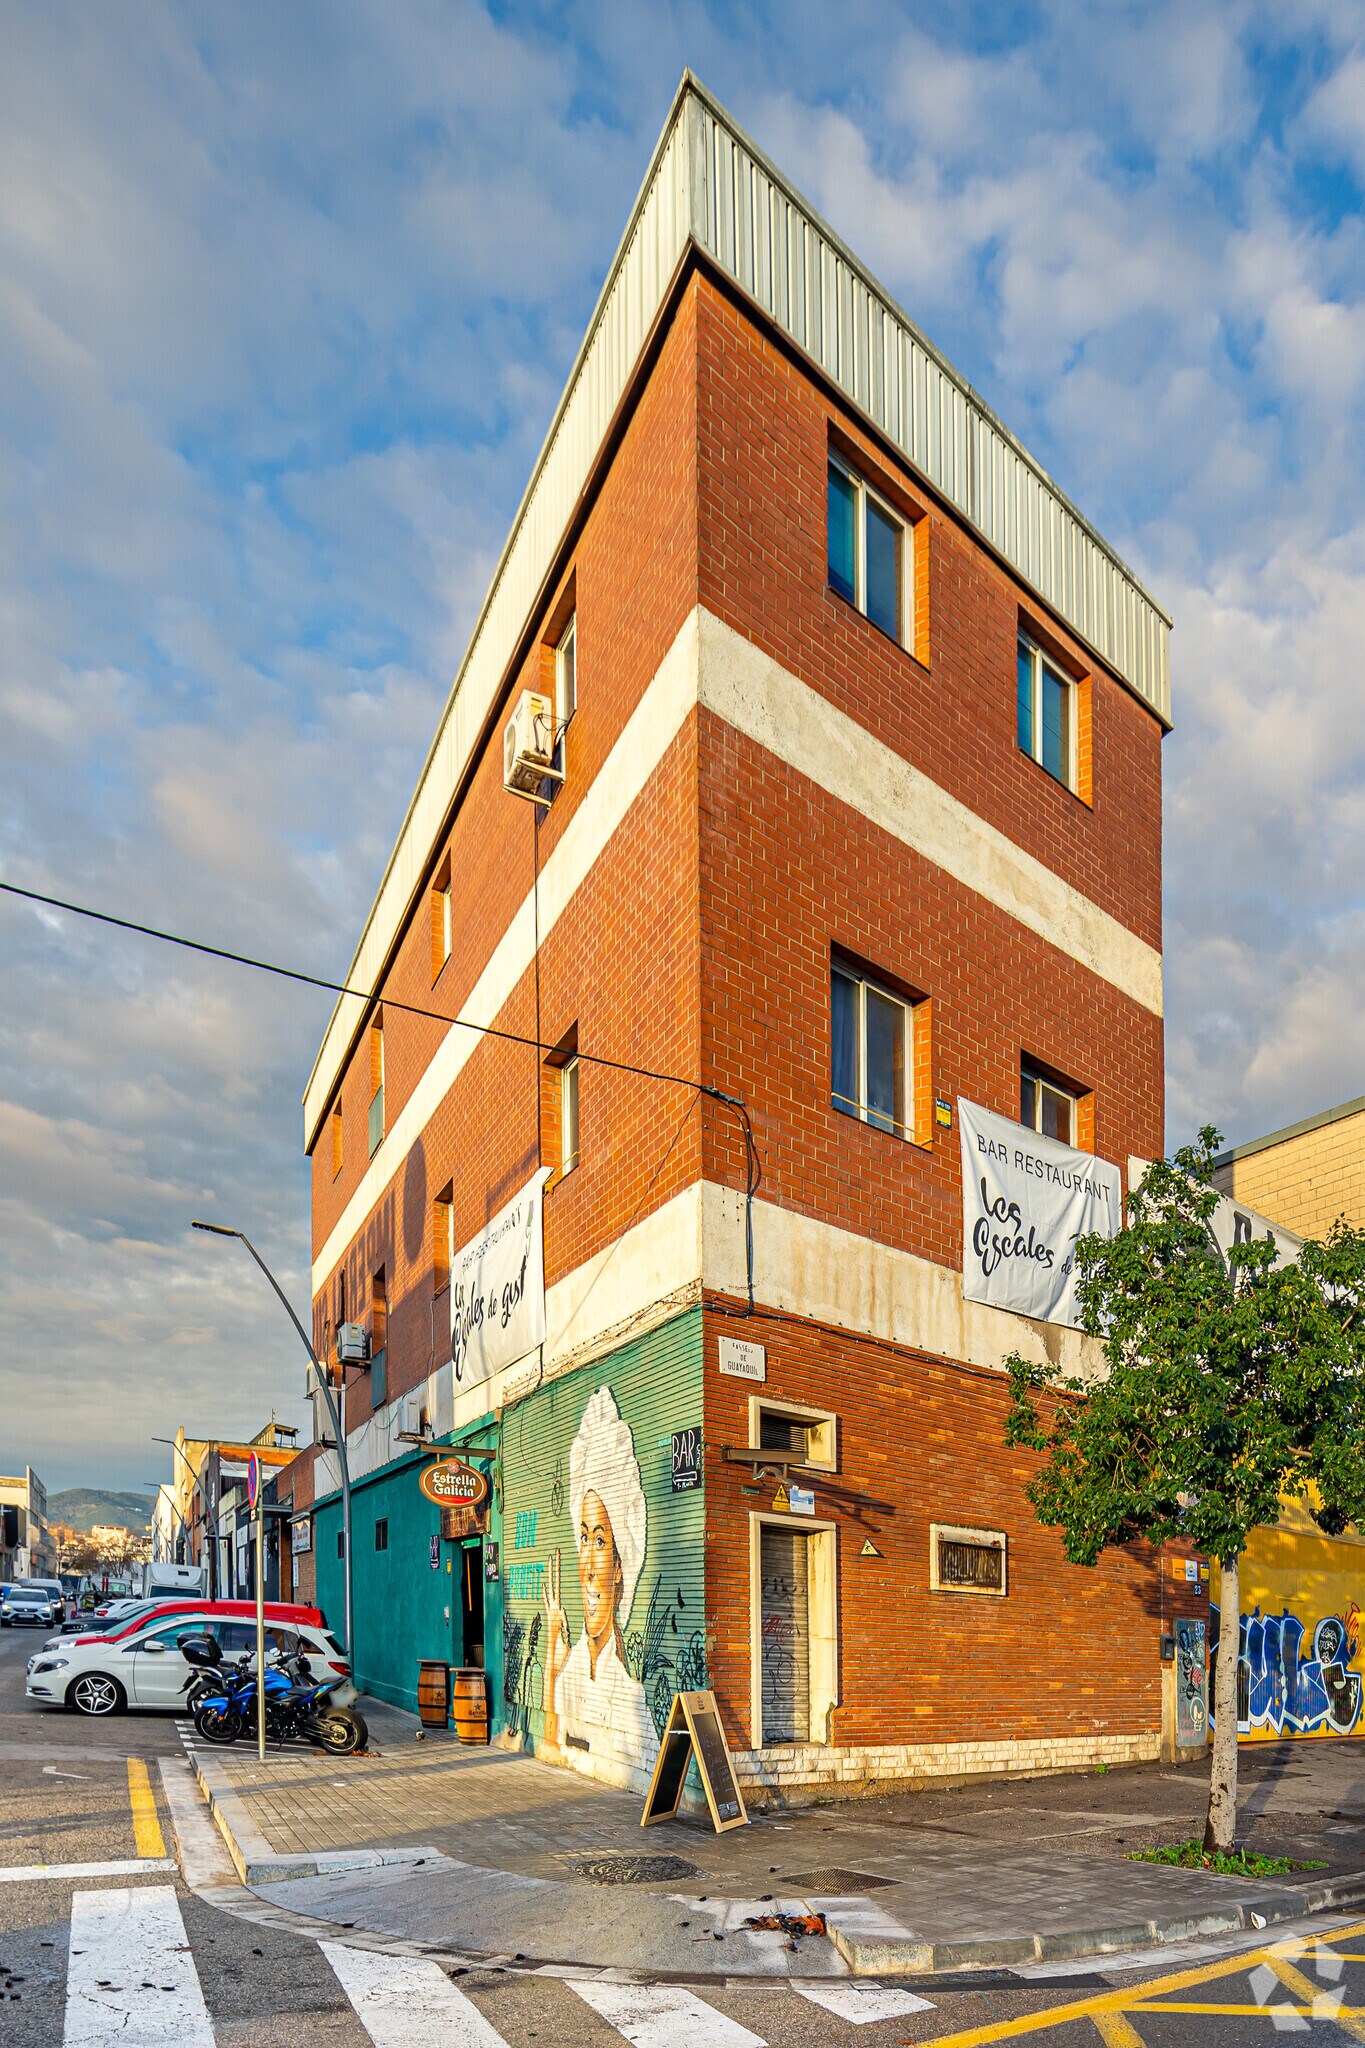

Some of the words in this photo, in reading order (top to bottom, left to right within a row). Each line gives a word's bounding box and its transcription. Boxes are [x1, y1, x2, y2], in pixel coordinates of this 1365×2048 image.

[976, 1133, 1008, 1164] BAR
[1014, 1150, 1110, 1203] RESTAURANT
[1061, 1256, 1073, 1276] de
[487, 1289, 498, 1319] de
[740, 1354, 747, 1362] DE
[727, 1360, 759, 1376] GUAYAQUIL
[672, 1429, 696, 1473] BAR
[432, 1471, 477, 1487] Estrella
[434, 1483, 475, 1497] Galicia
